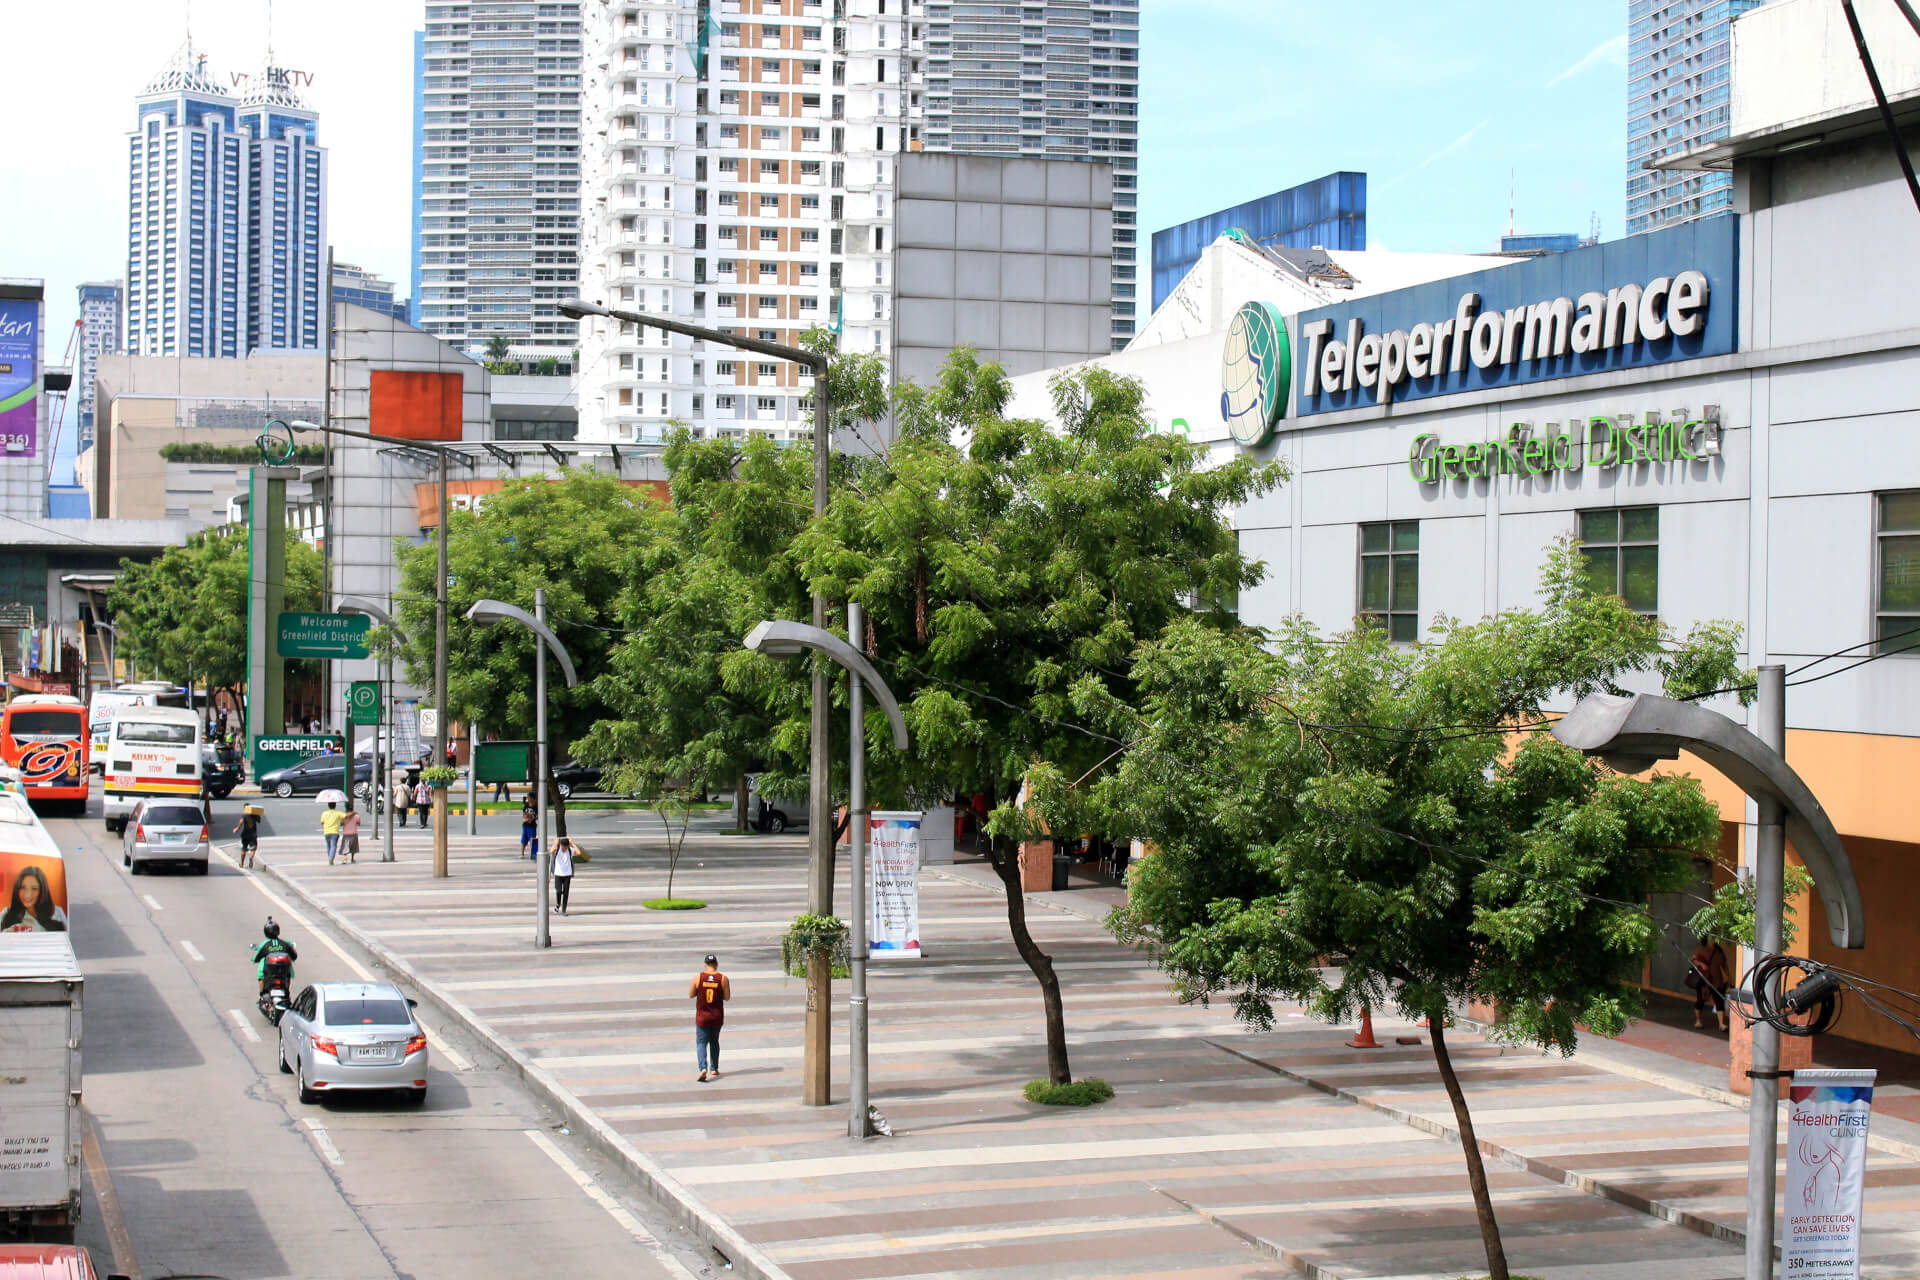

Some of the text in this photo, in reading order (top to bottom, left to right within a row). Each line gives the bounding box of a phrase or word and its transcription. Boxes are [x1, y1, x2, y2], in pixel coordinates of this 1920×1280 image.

[267, 67, 314, 87] HKTV
[1303, 270, 1710, 403] Teleperformance
[1588, 406, 1718, 469] District
[300, 615, 349, 627] Welcome
[281, 629, 365, 641] Greenfield District
[259, 739, 334, 751] GREENFIELD
[874, 839, 917, 849] HealthFirst
[1793, 1112, 1867, 1126] HealthFirst
[1830, 1128, 1865, 1137] CLINIC
[1791, 1215, 1855, 1224] EARLY DETECTION
[1793, 1224, 1850, 1234] CAN SAVE LIVES
[1788, 1258, 1804, 1269] 350
[1806, 1260, 1831, 1268] METERS
